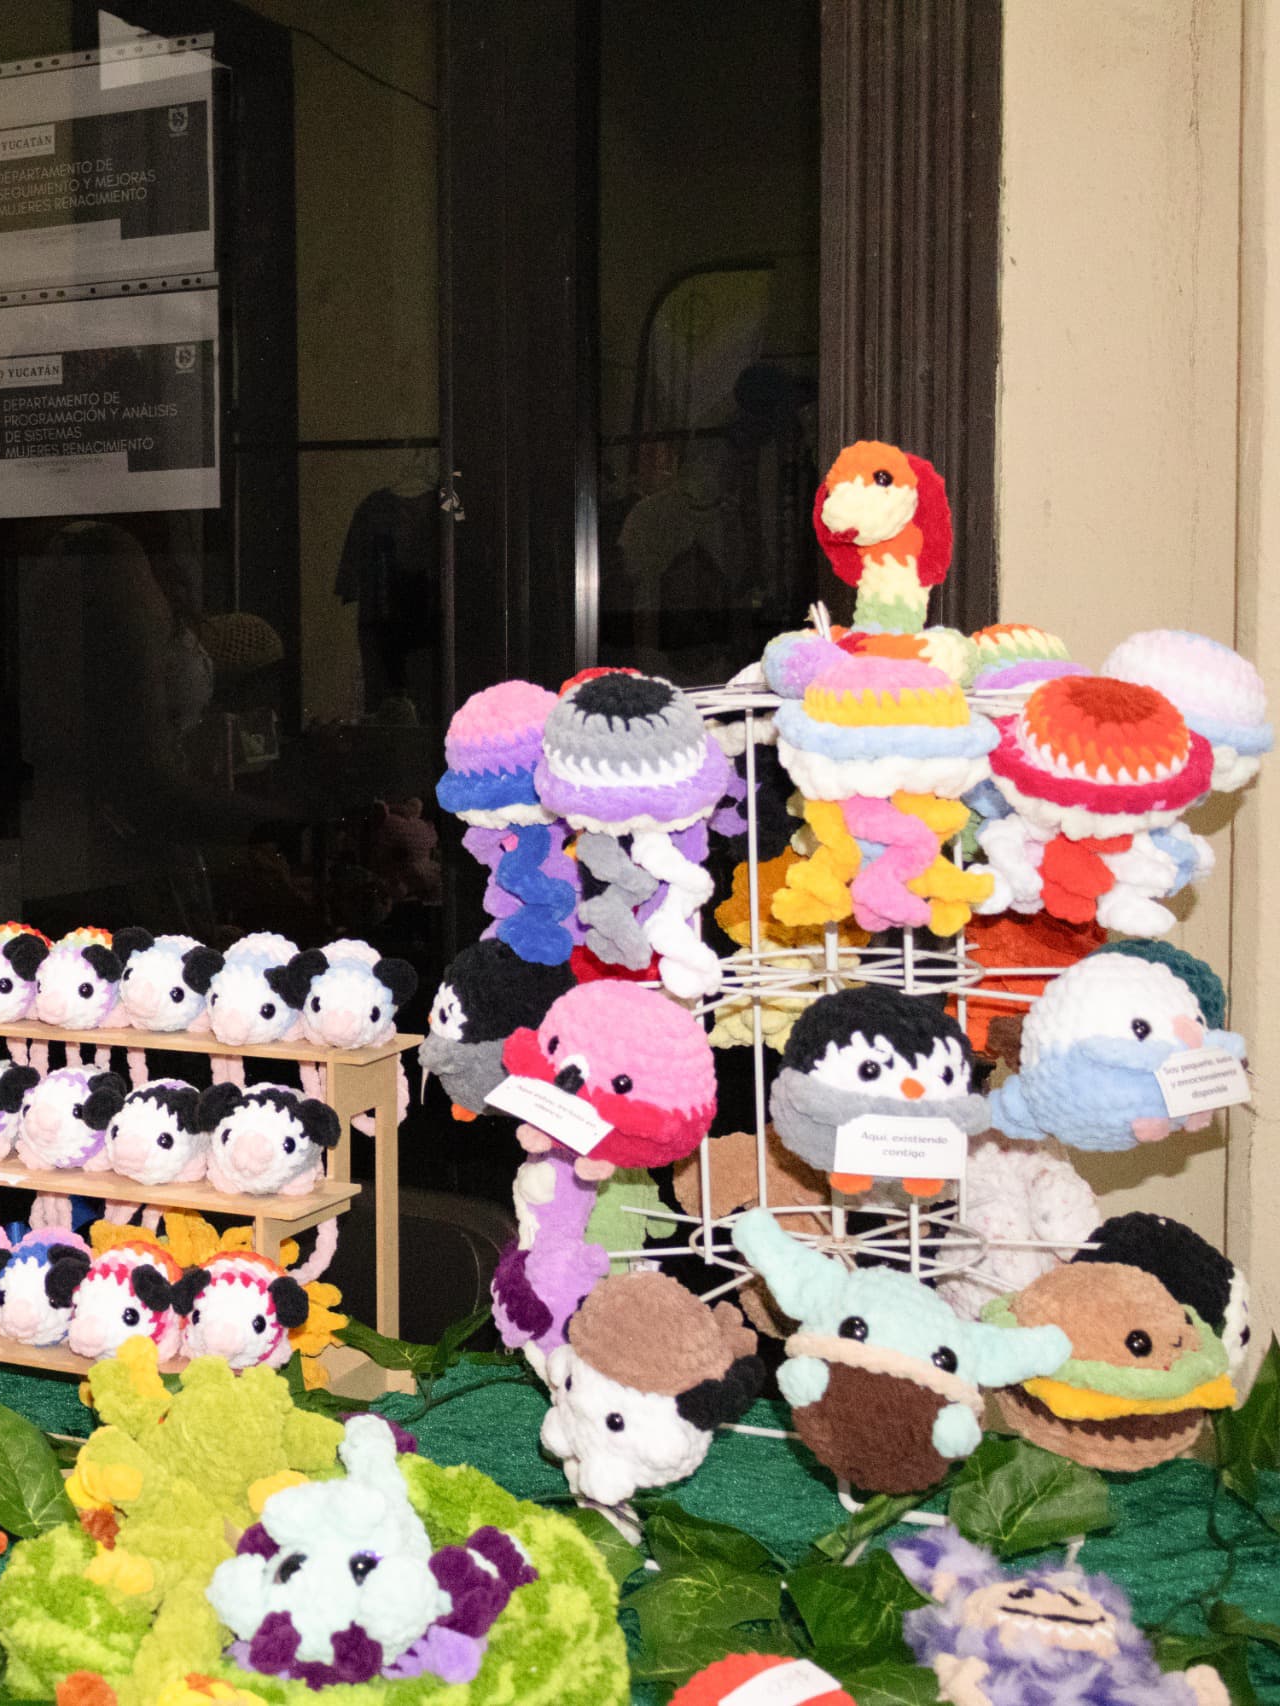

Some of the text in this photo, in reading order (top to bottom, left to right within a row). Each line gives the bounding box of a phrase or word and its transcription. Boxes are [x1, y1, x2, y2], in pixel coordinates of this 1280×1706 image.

[96, 158, 114, 173] DE
[84, 177, 92, 190] Y
[95, 169, 157, 189] MEJORAS
[54, 187, 148, 210] RENACIMIENTO
[2, 390, 121, 413] DEPARTAMENTO DE
[4, 401, 178, 427] PROGRAMACIÓN Y ANÁLISIS
[5, 426, 82, 444] DE SISTEMAS
[5, 436, 154, 459] MUJERES RENACIMIENTO
[892, 1133, 948, 1145] existiendo
[882, 1147, 925, 1159] contigo
